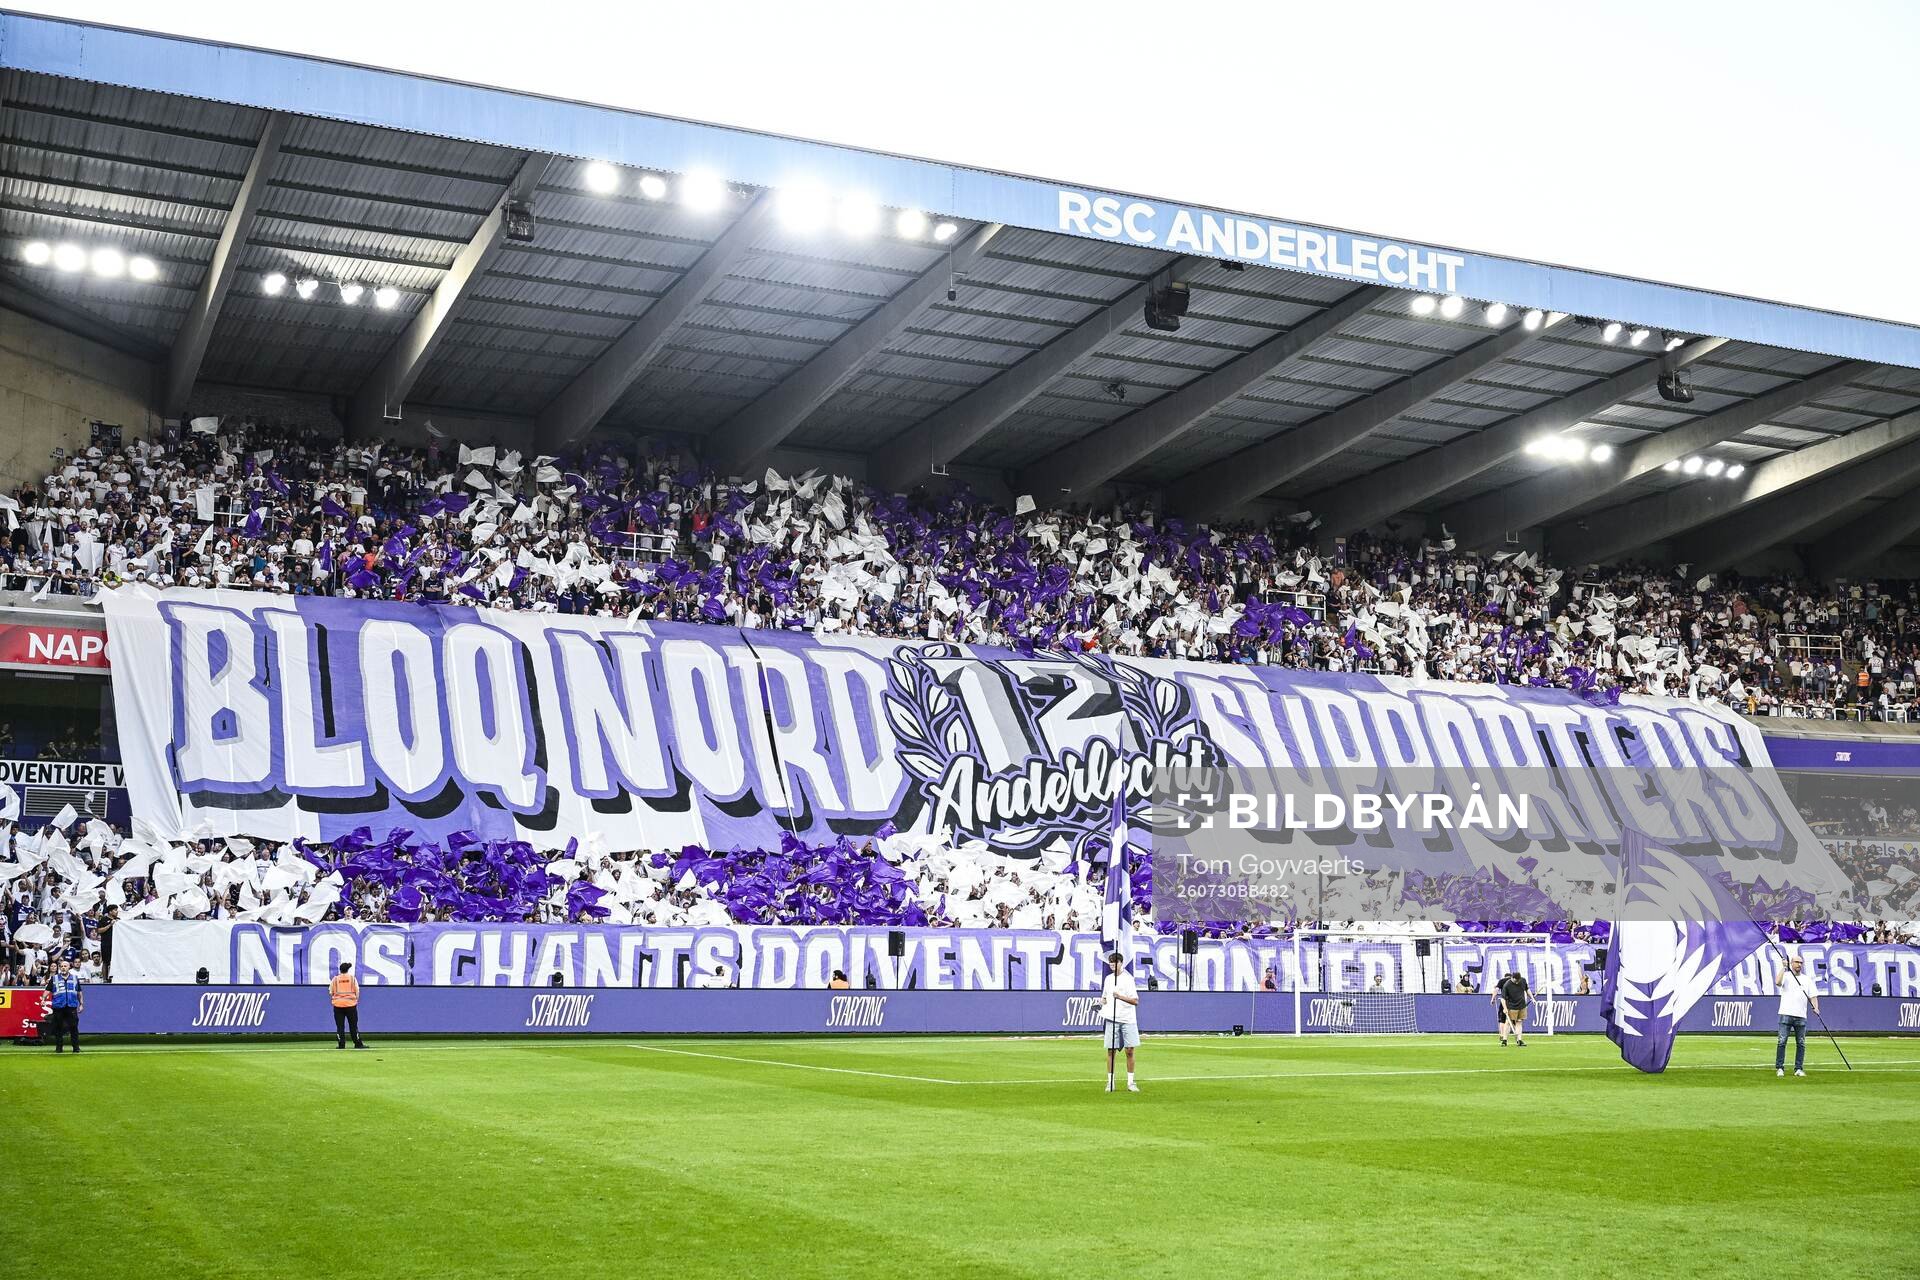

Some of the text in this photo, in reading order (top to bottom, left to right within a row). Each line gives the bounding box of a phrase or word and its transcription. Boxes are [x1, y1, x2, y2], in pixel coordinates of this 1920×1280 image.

[1058, 190, 1465, 292] RSC ANDERLECHT
[160, 602, 905, 818] BLOQ NORD
[918, 657, 1142, 776] 12
[1178, 674, 1782, 848] SUPPORTERS
[236, 930, 408, 985] NOS
[431, 930, 740, 988] CHANTS
[758, 934, 1061, 990] DOIVENT
[192, 992, 271, 1027] STARTING
[526, 994, 595, 1027] STARTING
[826, 996, 887, 1027] STARTING
[1062, 996, 1104, 1026] START
[1307, 998, 1356, 1027] STARTING
[1711, 1001, 1753, 1027] STARTING
